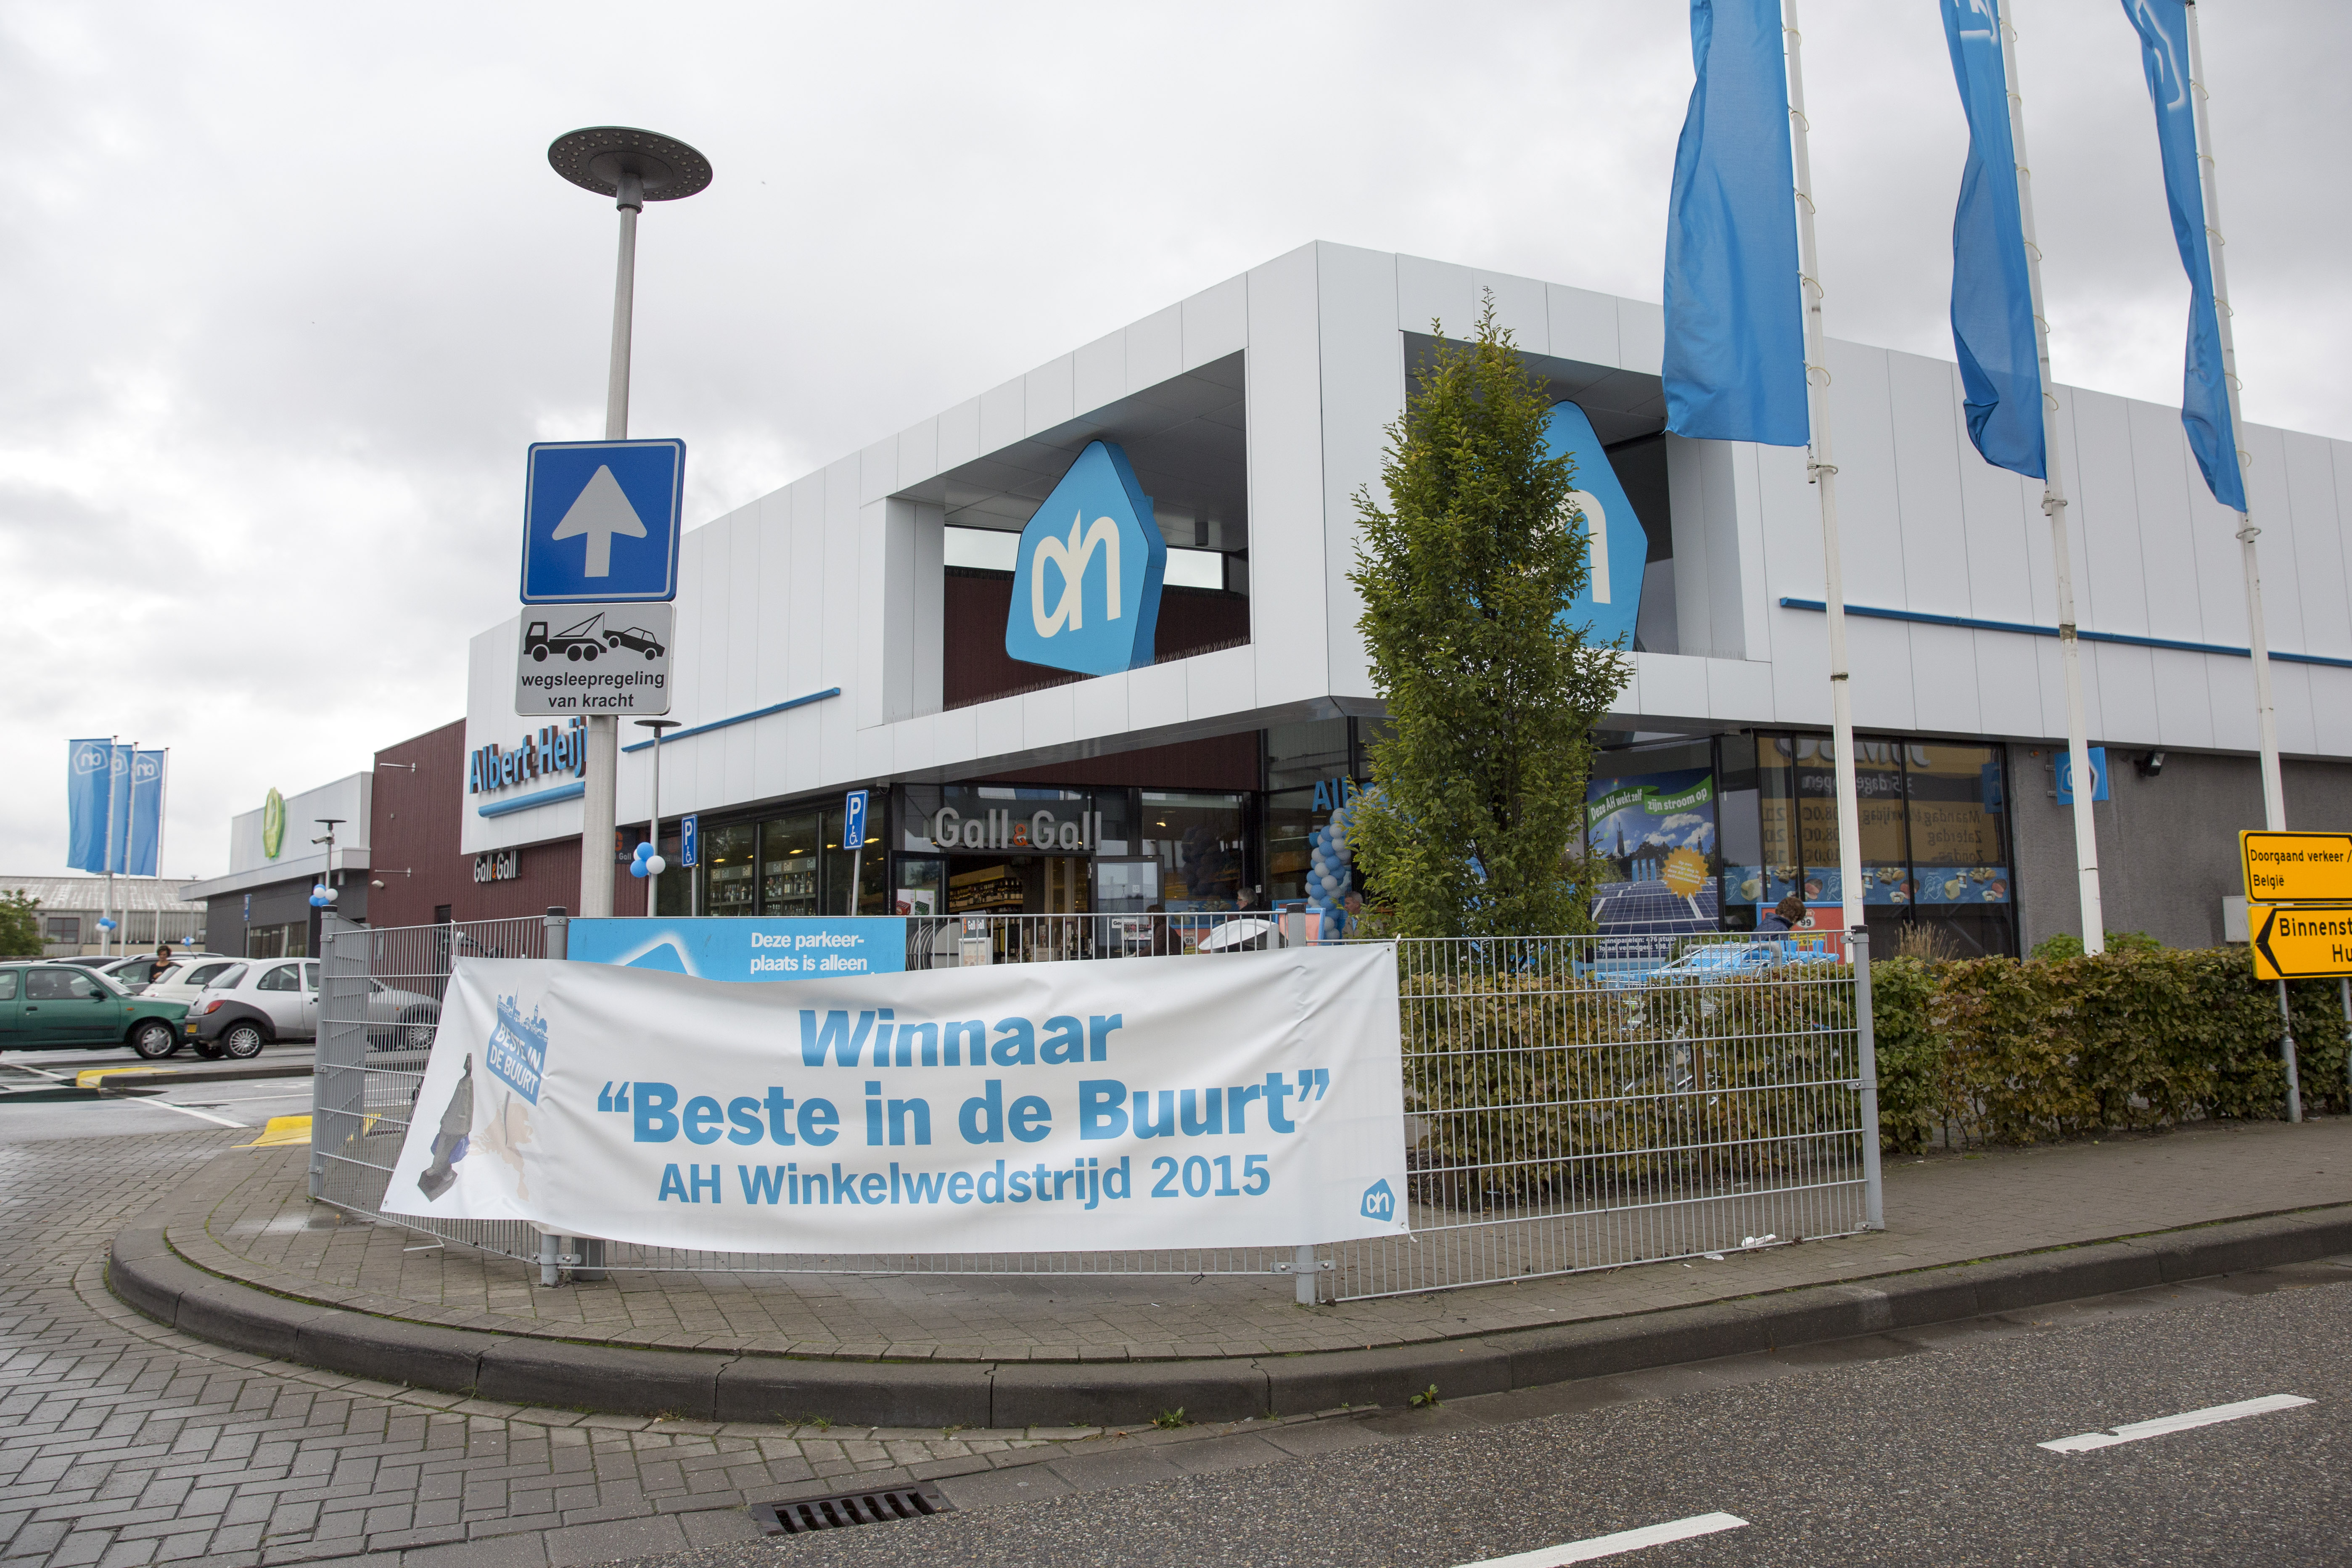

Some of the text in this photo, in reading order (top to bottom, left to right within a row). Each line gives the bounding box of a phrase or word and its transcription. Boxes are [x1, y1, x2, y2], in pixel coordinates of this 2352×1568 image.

[521, 671, 665, 690] wegsleepregeling
[548, 693, 634, 708] van kracht
[469, 715, 588, 794] Albert Heij
[1590, 788, 1707, 821] Deze AH wekt zelf zijn stroom op
[2250, 849, 2304, 865] Doorgaand
[2307, 850, 2344, 862] verkeer
[2253, 874, 2285, 890] België
[752, 931, 864, 951] Deze parkeer-
[751, 955, 868, 974] plaats is alleen
[495, 1021, 542, 1072] BESTE IN
[799, 1009, 1123, 1067] Winnaar
[489, 1044, 539, 1095] DE BUURT
[865, 1081, 931, 1146] in
[959, 1079, 1052, 1145] de
[658, 1155, 1270, 1210] AH Winkelwedstrijd 2015
